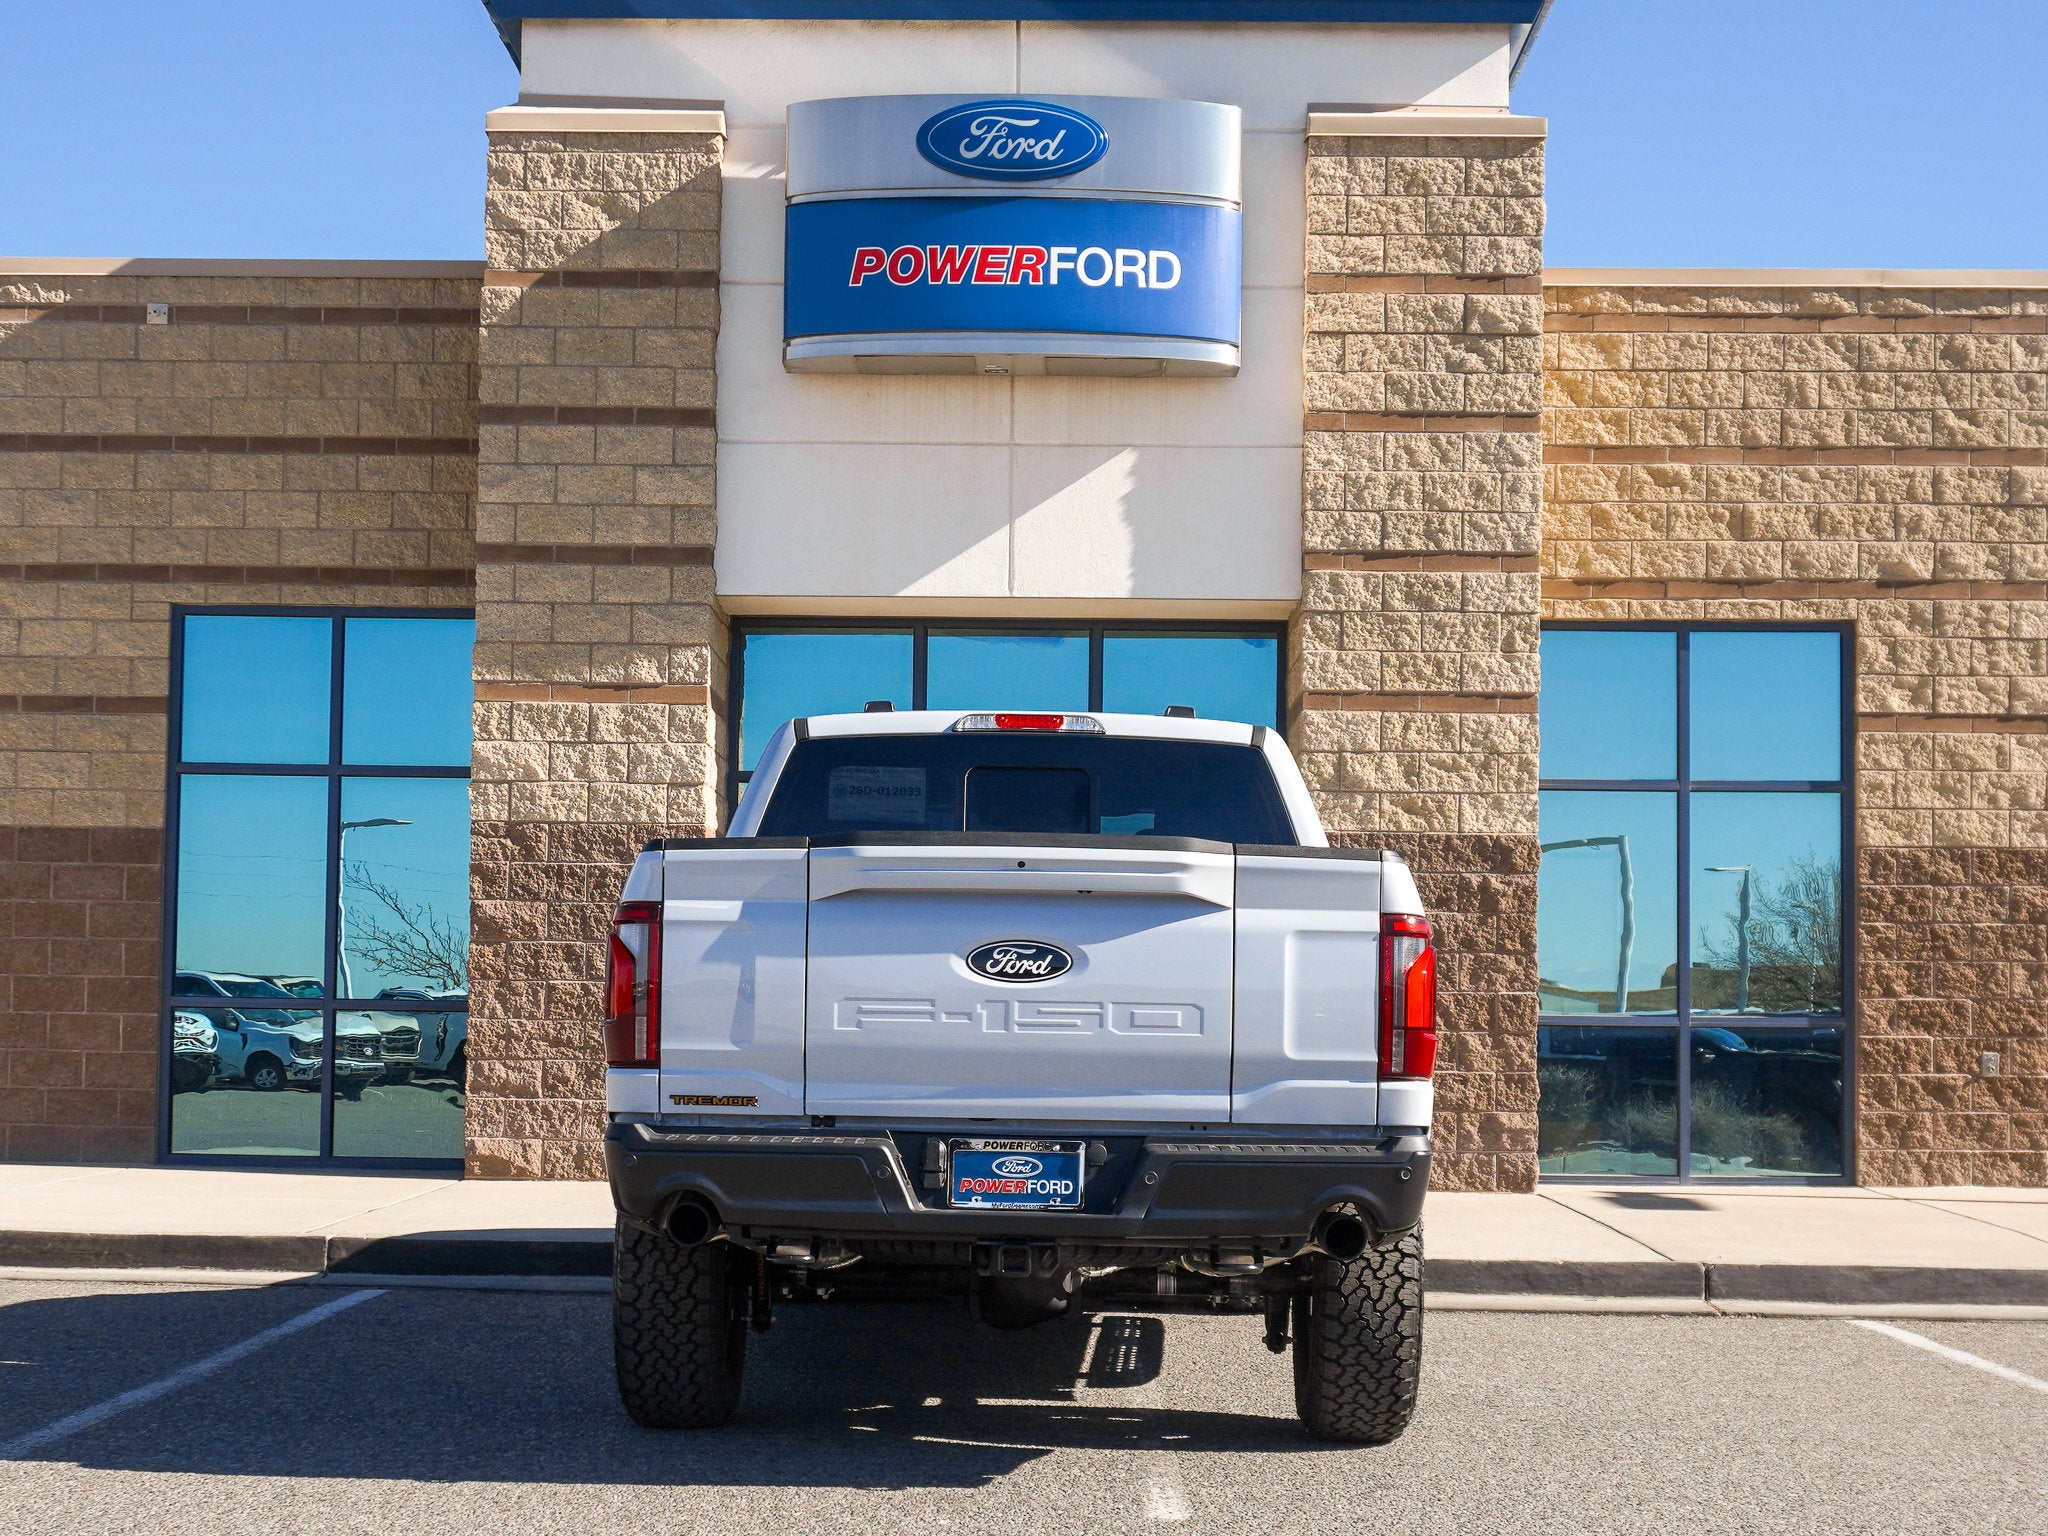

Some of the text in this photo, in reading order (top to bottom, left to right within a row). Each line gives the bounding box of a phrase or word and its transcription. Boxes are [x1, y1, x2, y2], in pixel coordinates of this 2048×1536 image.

[959, 115, 1064, 161] Ford
[848, 245, 1182, 290] POWERFORD
[985, 946, 1053, 976] Ford
[833, 996, 1205, 1037] F-150
[669, 1094, 758, 1107] TREMOR
[983, 1140, 1053, 1151] POWERFORD
[1002, 1160, 1032, 1173] Ford
[959, 1177, 1074, 1195] POWERFORD
